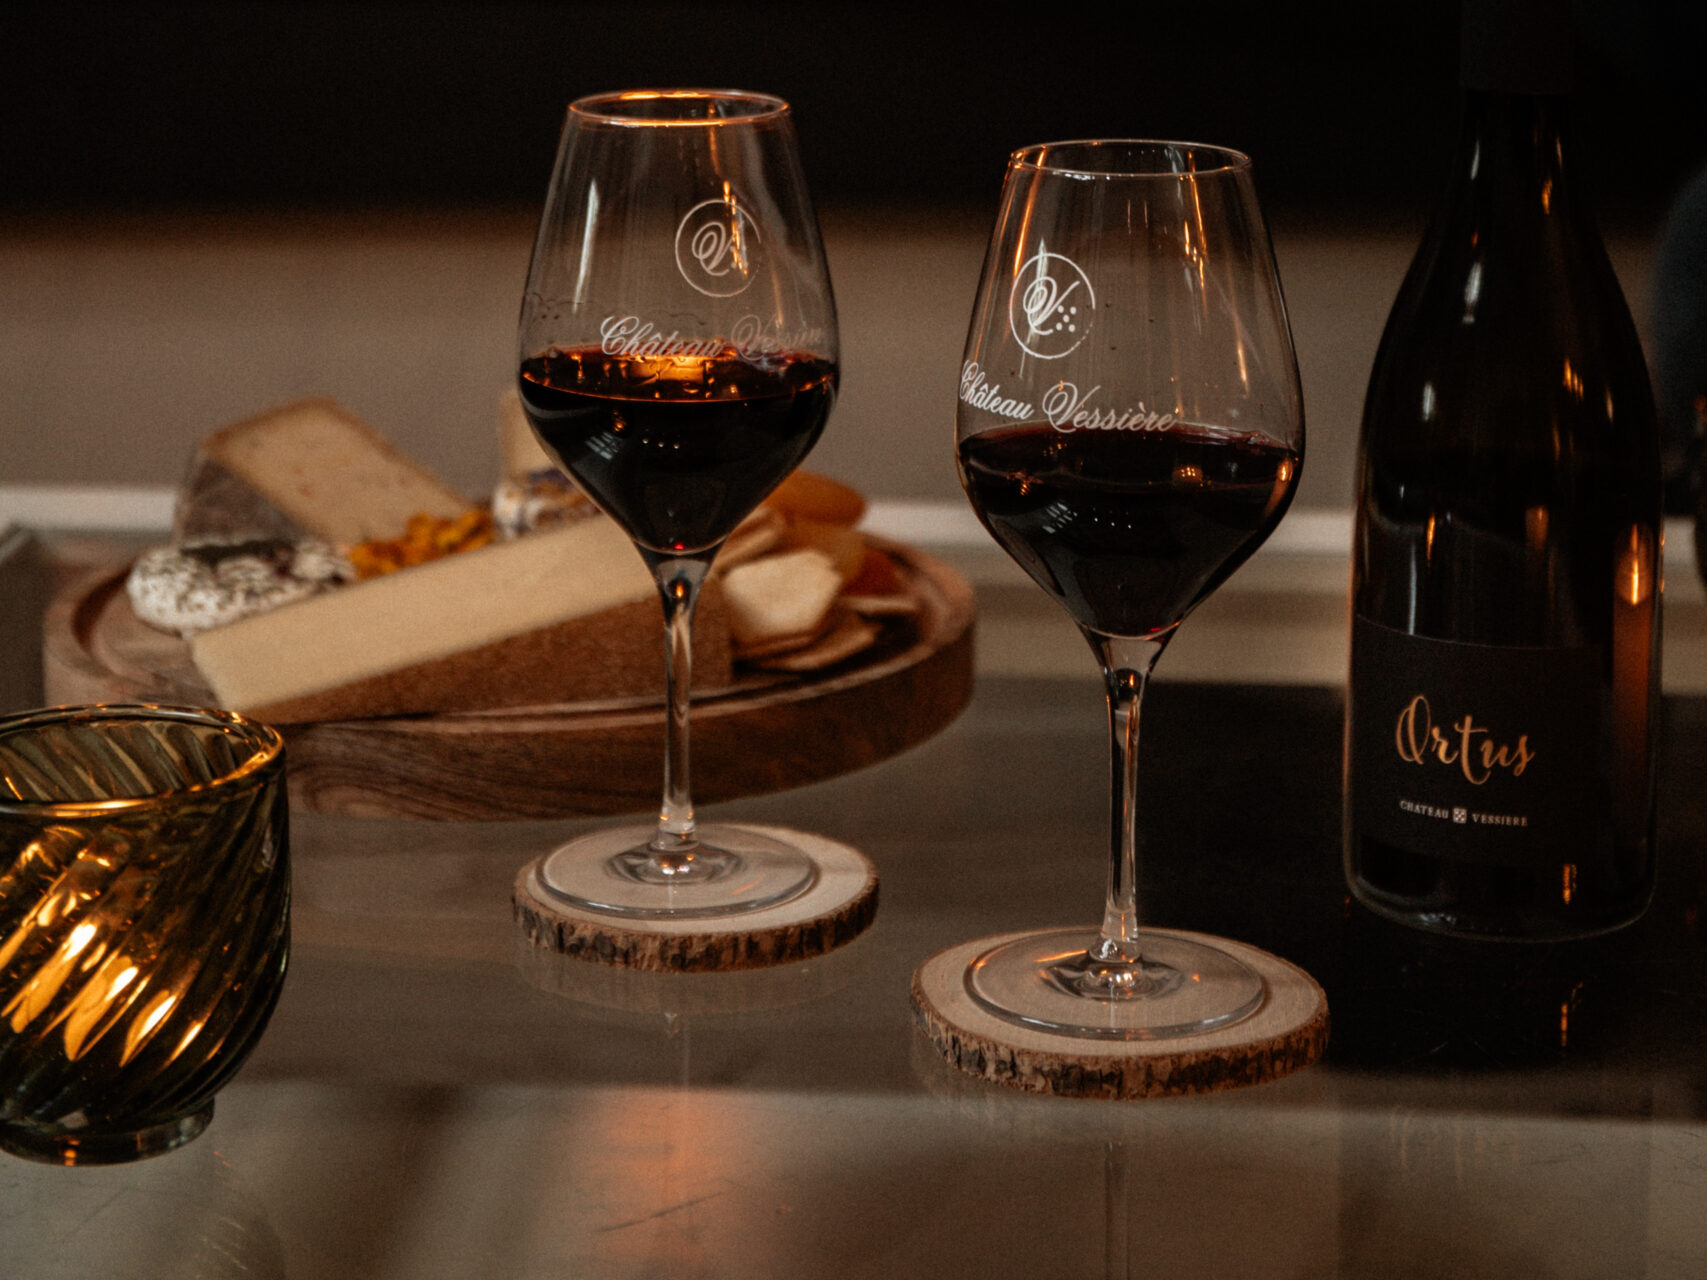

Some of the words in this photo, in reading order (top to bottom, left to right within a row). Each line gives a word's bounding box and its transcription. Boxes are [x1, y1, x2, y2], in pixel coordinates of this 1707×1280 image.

[600, 315, 725, 357] Château
[960, 360, 1035, 420] Château
[1042, 382, 1176, 433] Vessière
[1395, 694, 1535, 785] Ortus
